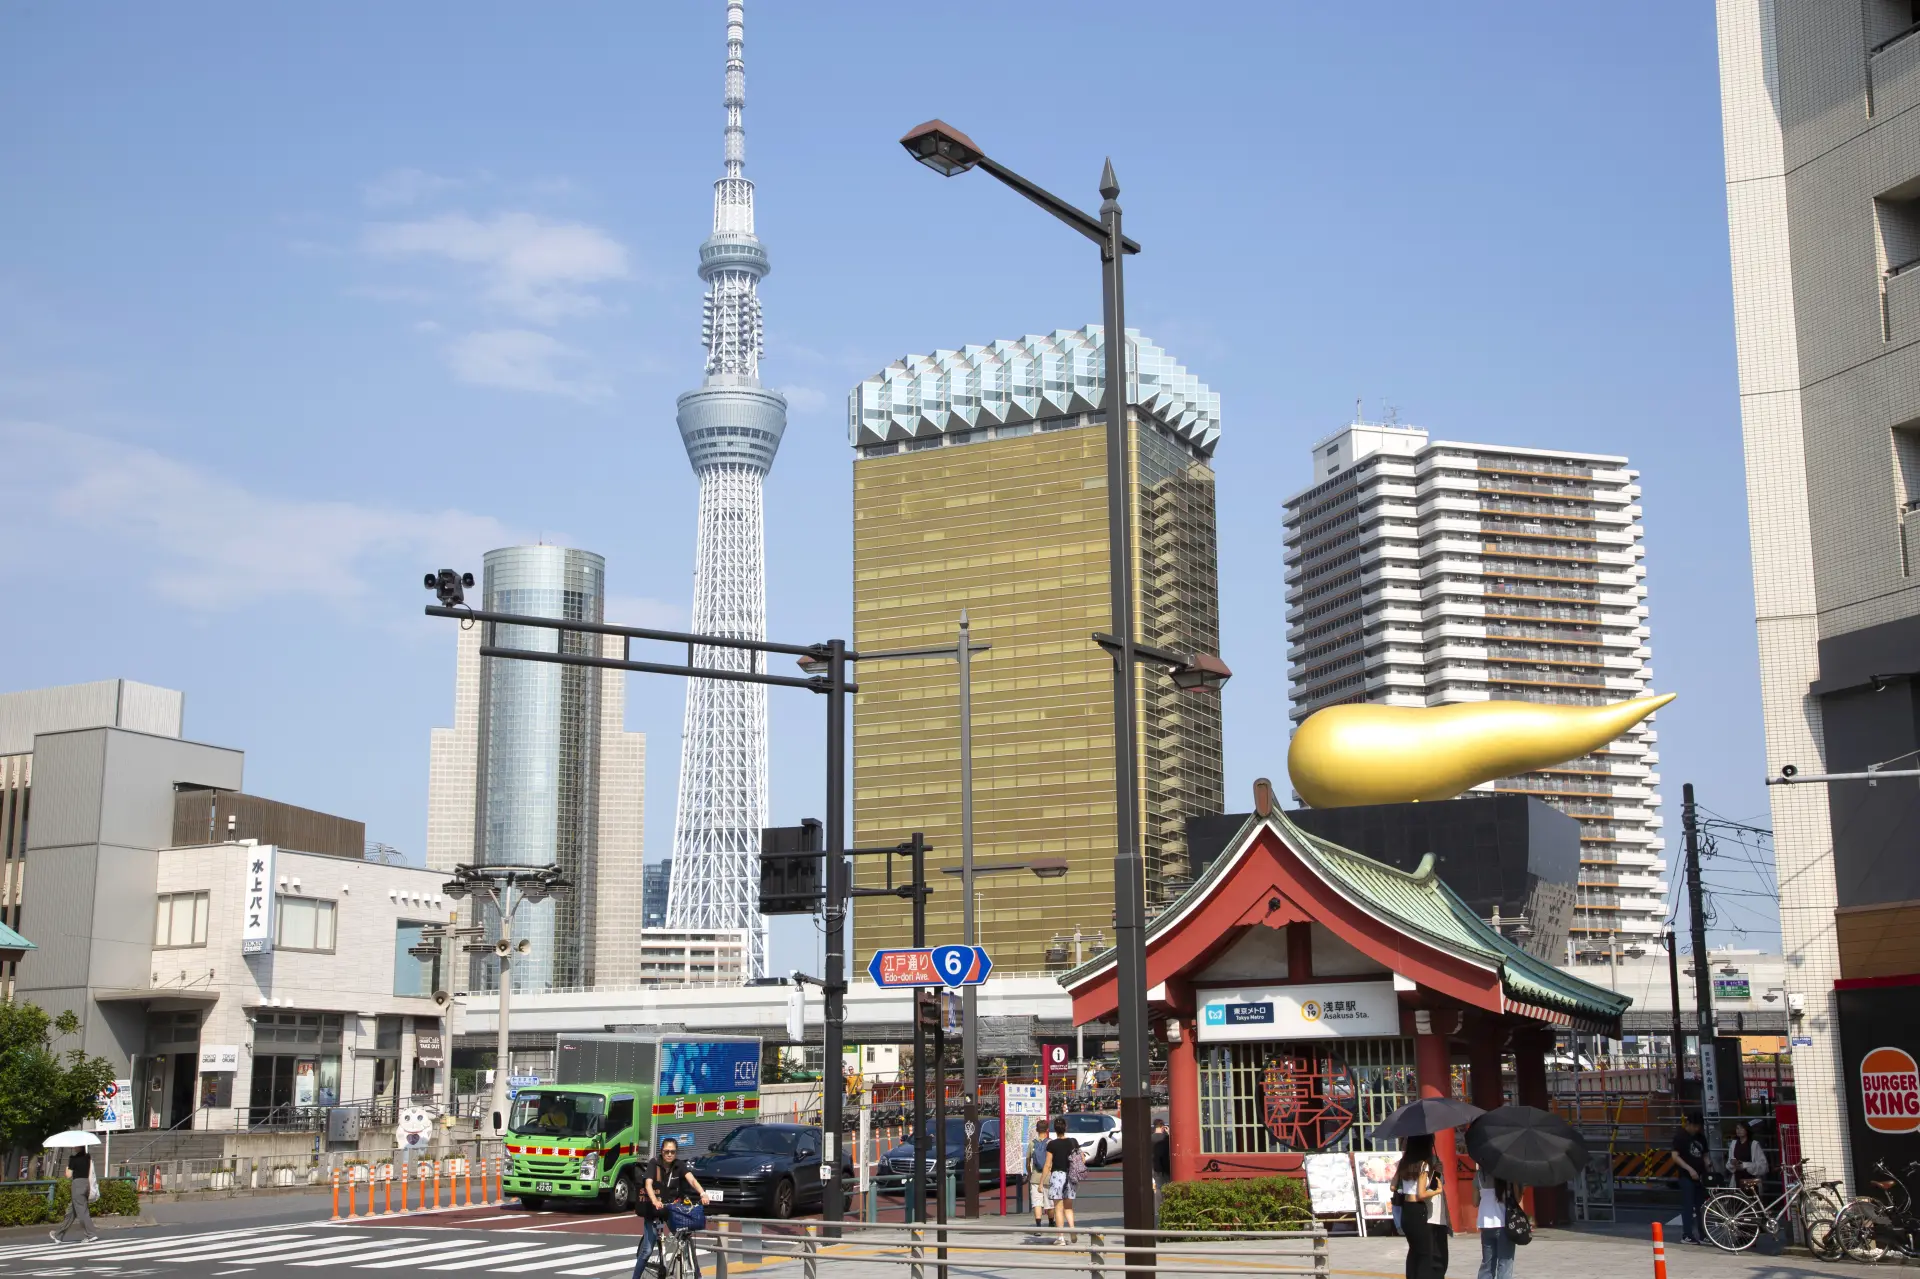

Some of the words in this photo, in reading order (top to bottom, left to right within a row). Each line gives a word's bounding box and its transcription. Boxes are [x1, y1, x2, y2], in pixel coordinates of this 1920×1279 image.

[249, 859, 264, 928] 水上バス
[884, 954, 929, 971] 江戸通り
[945, 950, 962, 975] 6
[884, 972, 914, 982] Edo-dori
[916, 972, 929, 981] Ave.
[1233, 1007, 1266, 1015] 東京メトロ
[1323, 1001, 1357, 1012] 浅草駅
[1323, 1011, 1354, 1019] Asakusa
[1355, 1011, 1369, 1019] Sta.
[734, 1061, 758, 1080] FCEV
[1862, 1074, 1918, 1091] BURGER
[674, 1094, 746, 1120] 福山通運
[1864, 1091, 1920, 1115] KING
